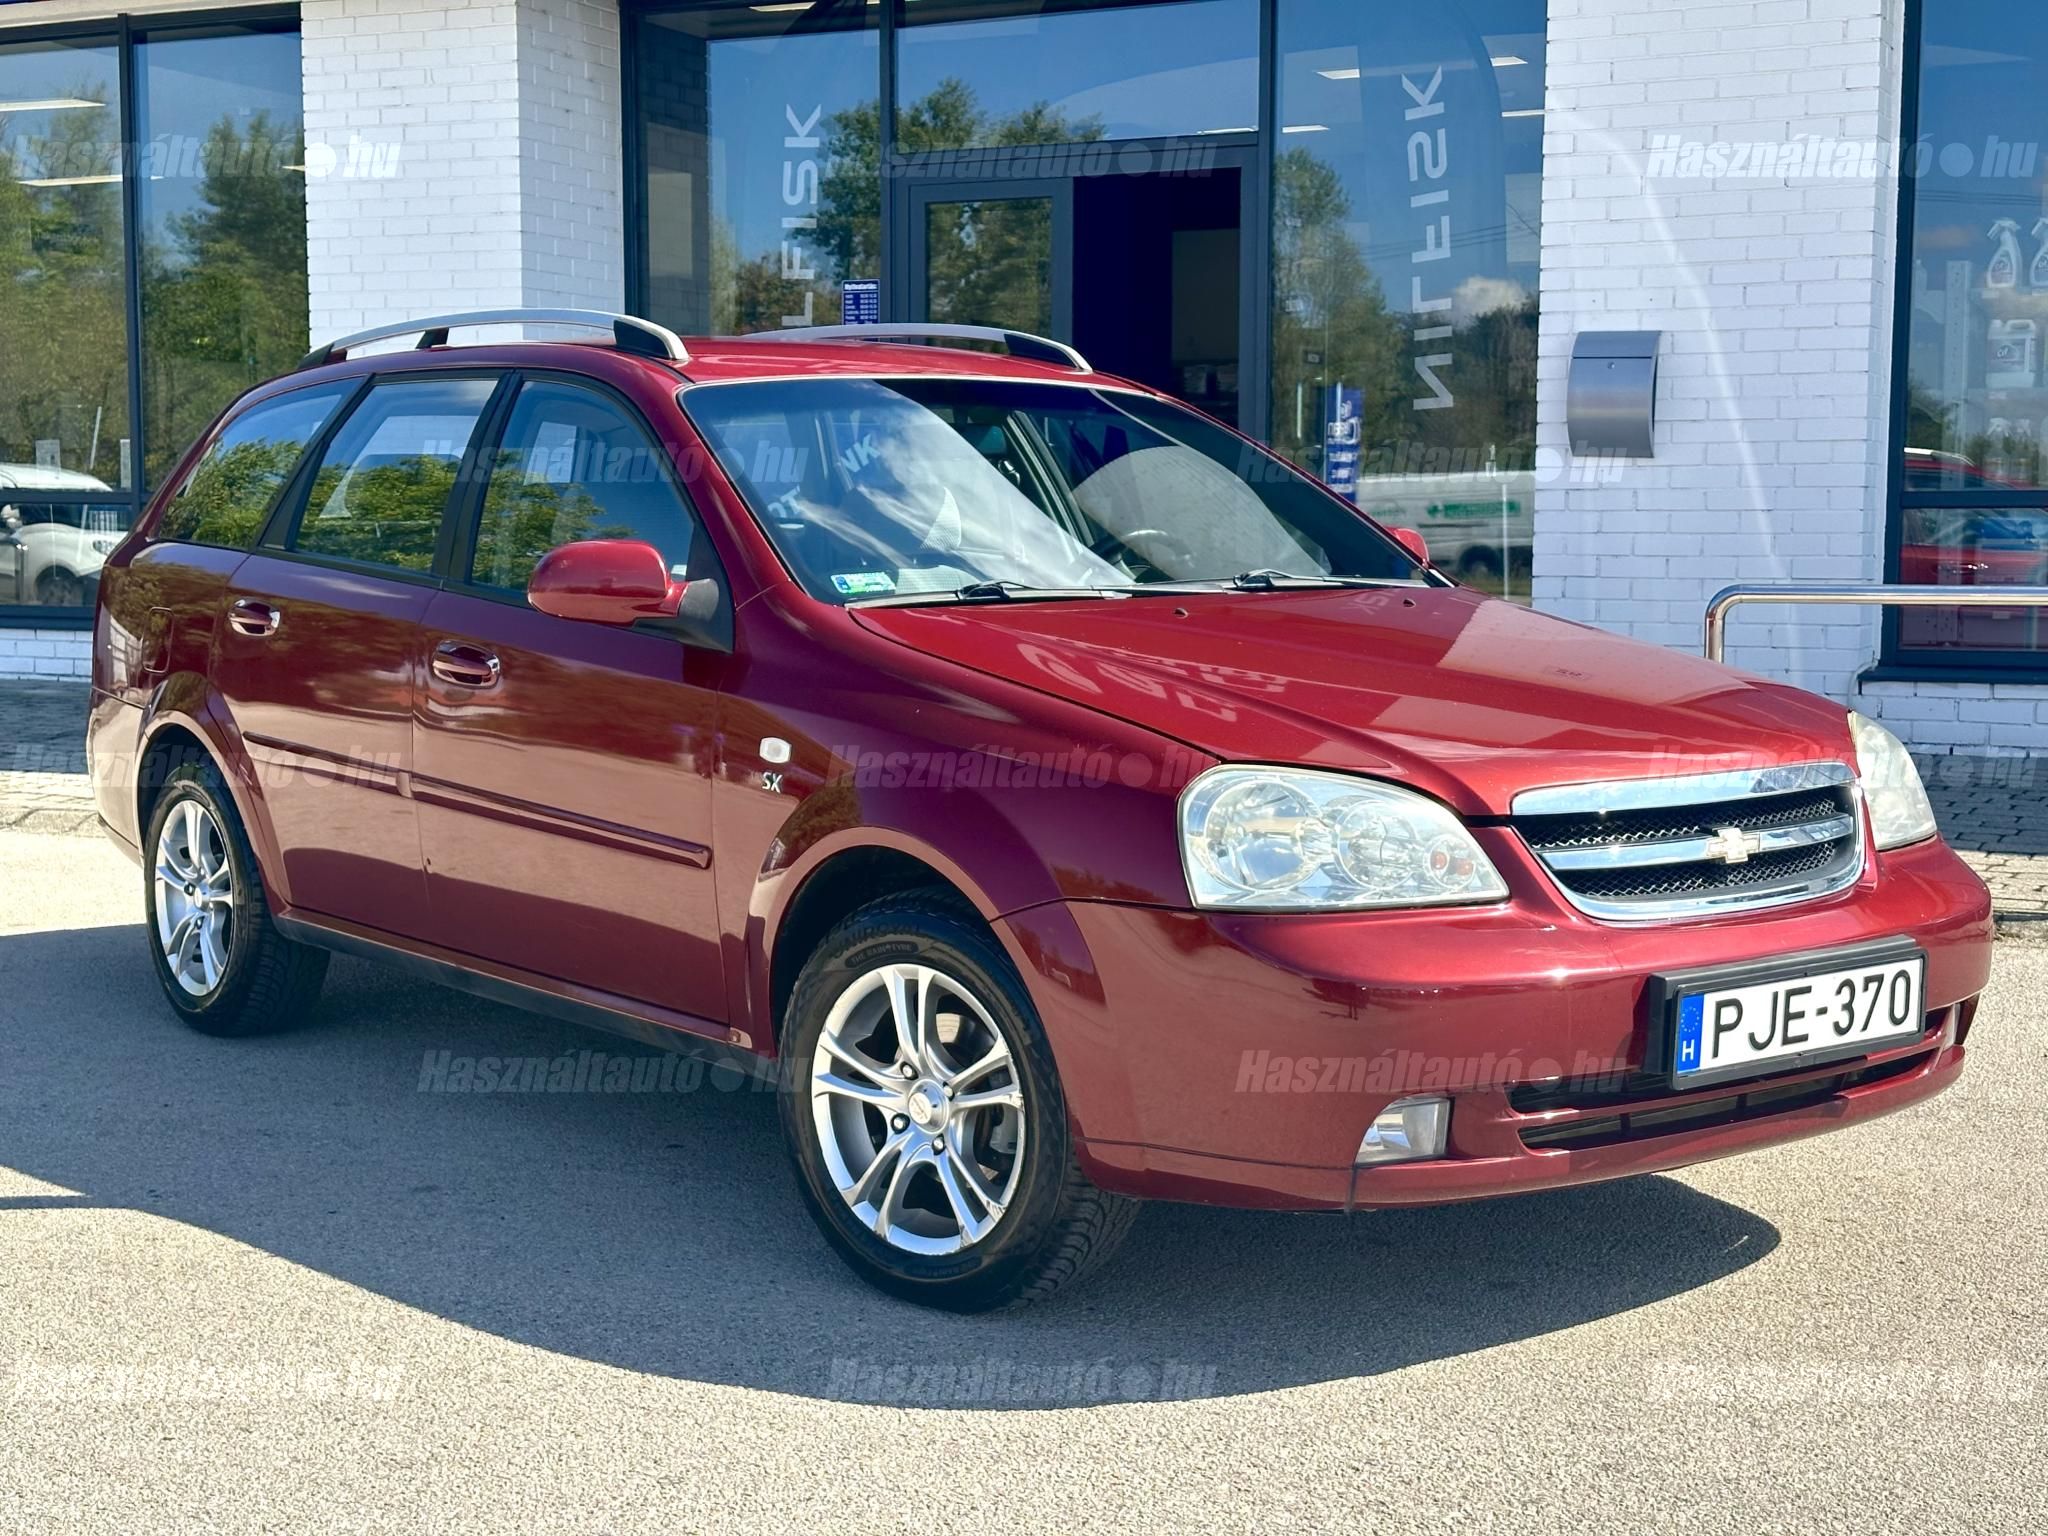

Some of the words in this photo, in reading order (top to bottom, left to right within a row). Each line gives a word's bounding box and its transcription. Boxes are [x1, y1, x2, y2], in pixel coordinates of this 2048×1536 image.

[781, 104, 822, 326] LFISK
[762, 771, 783, 794] SX
[1711, 968, 1912, 1060] PJE-370
[1681, 1039, 1695, 1062] H
